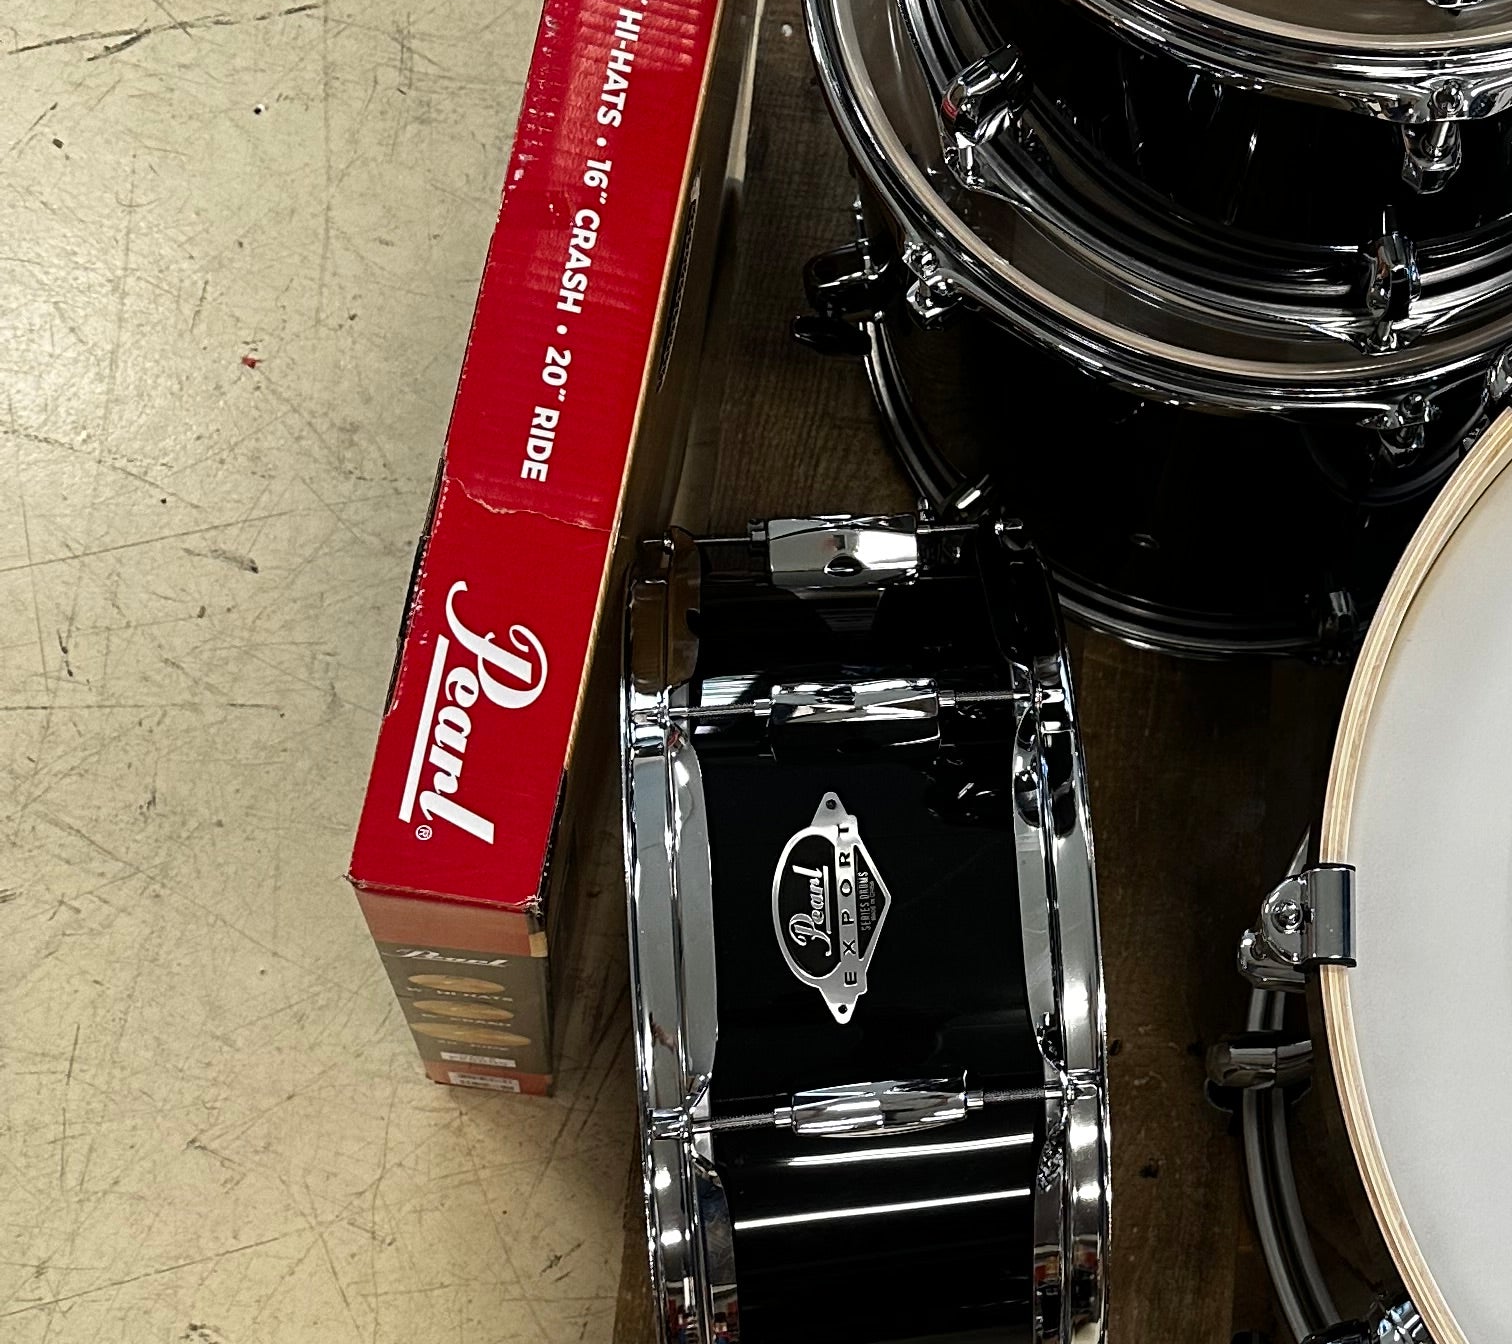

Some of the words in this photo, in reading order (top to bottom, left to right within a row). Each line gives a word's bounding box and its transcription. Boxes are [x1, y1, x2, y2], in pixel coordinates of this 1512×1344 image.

[596, 7, 644, 128] HI-HATS
[583, 158, 613, 205] 16"
[556, 208, 600, 315] CRASH
[541, 345, 572, 403] 20"
[520, 405, 561, 483] RIDE
[788, 864, 832, 957] Pearl
[837, 823, 858, 987] EXPORT
[859, 902, 871, 931] SERIES
